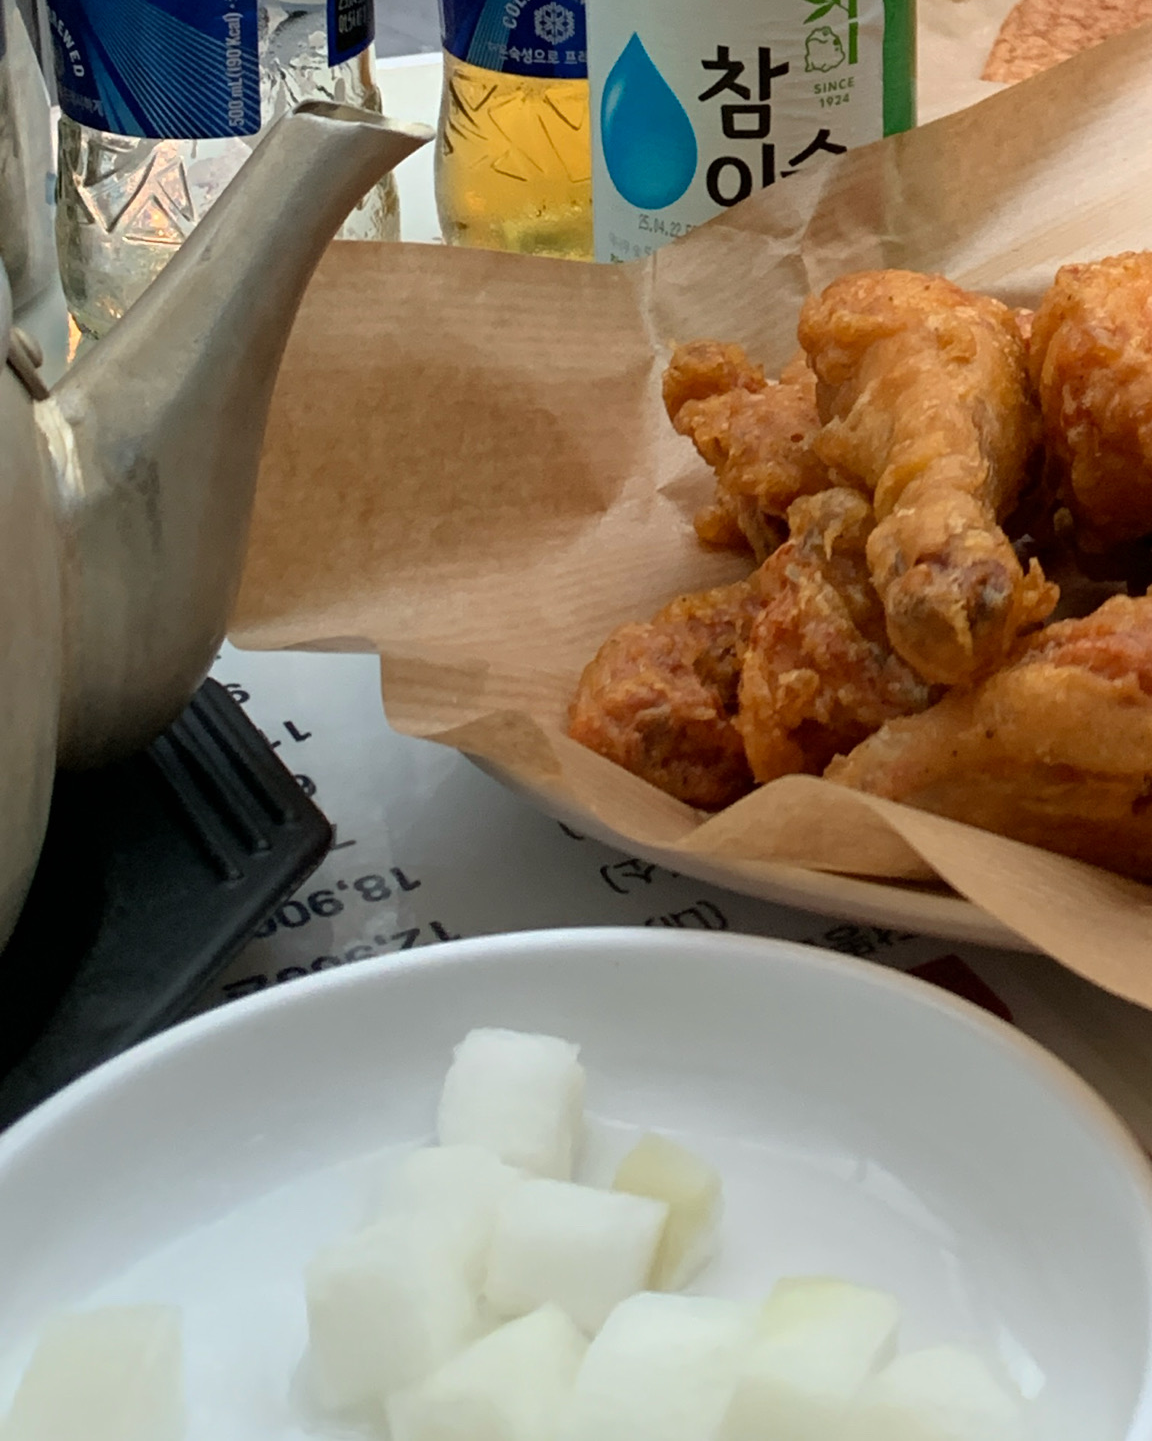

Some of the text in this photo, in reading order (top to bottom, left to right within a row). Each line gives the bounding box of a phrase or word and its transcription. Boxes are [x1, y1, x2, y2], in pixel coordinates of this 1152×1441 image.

[698, 44, 790, 139] 참
[813, 76, 855, 95] SINCE
[819, 93, 850, 108] 1924
